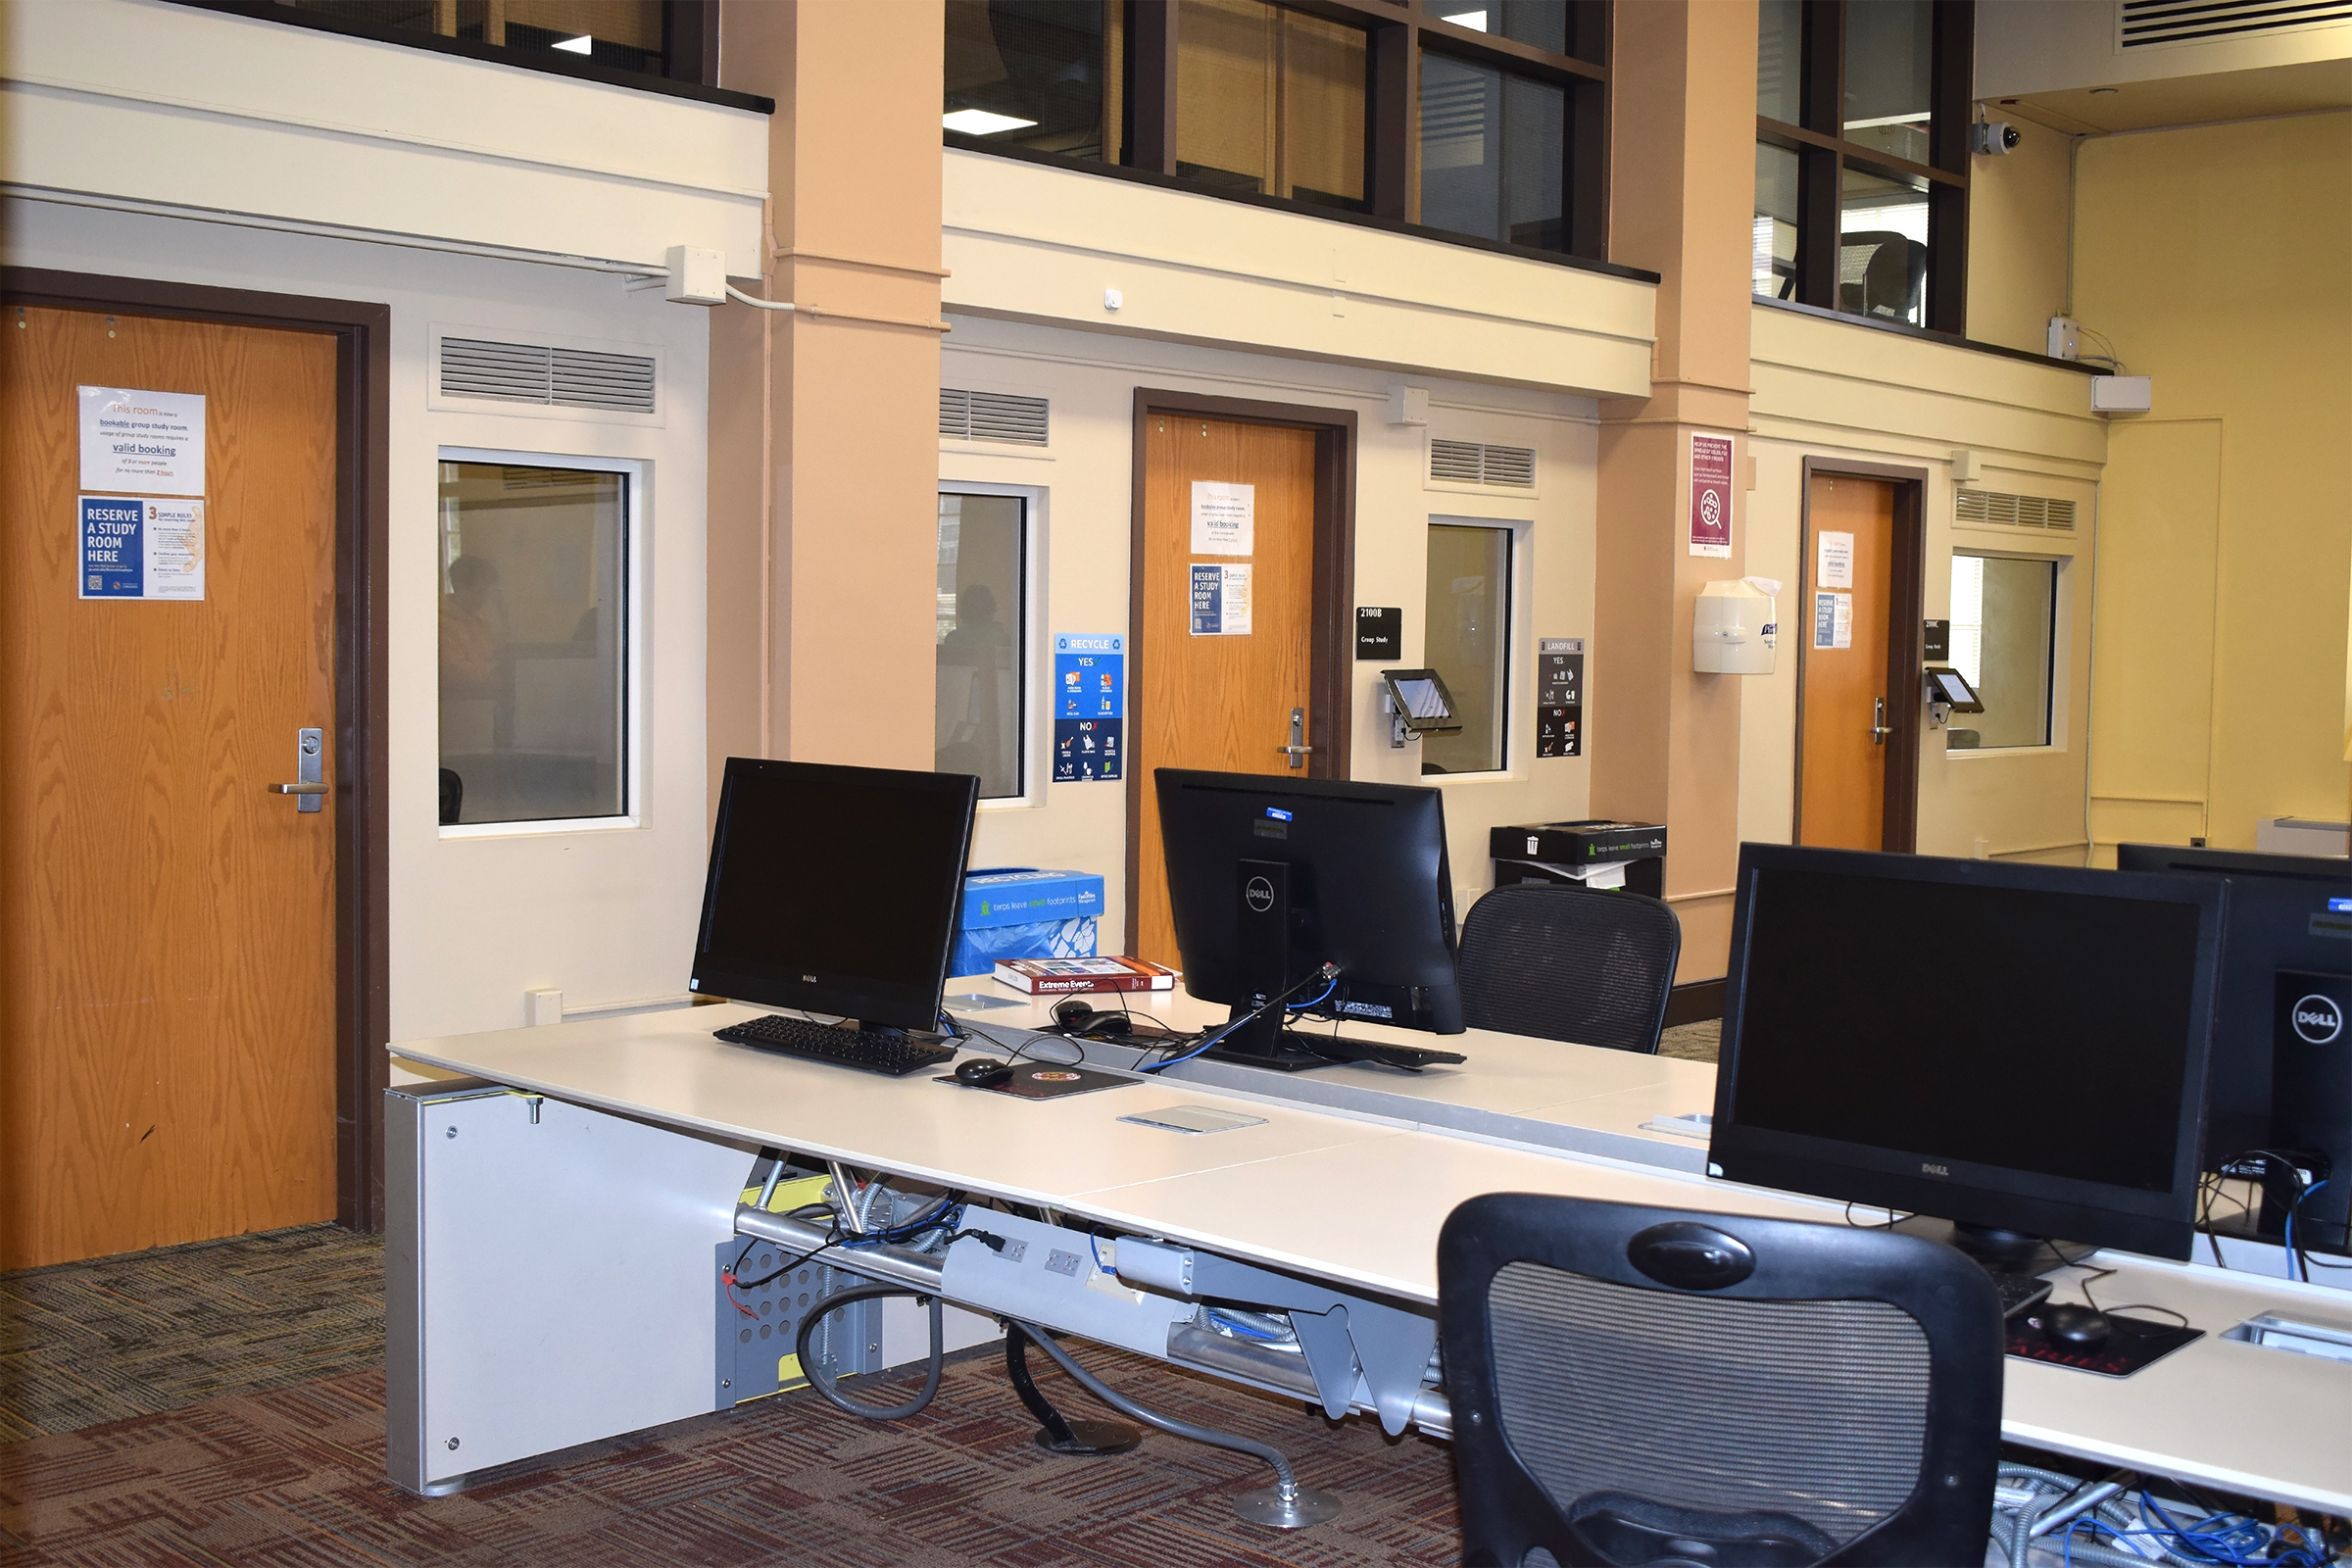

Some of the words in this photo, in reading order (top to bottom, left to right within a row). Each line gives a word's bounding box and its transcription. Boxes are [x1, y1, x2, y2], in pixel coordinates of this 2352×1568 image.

[112, 404, 130, 414] This
[113, 443, 136, 454] valid
[138, 444, 176, 457] booking
[87, 509, 138, 521] RESERVE
[149, 506, 157, 520] 3
[87, 522, 96, 534] A
[98, 522, 136, 535] STUDY
[1220, 520, 1239, 529] booking
[87, 536, 122, 549] ROOM
[88, 551, 119, 563] HERE
[1195, 572, 1220, 581] RESERVE
[1224, 570, 1229, 579] 3
[1200, 582, 1219, 591] STUDY
[1360, 609, 1382, 617] 2100B
[1071, 639, 1109, 650] RECYCLE
[1361, 636, 1375, 645] Group
[1078, 658, 1094, 666] YES
[1080, 722, 1093, 731] NO
[1250, 889, 1271, 900] DELL
[1047, 896, 1076, 906] footprints
[2298, 1011, 2336, 1027] DELL
[1922, 1162, 1949, 1176] DELL
